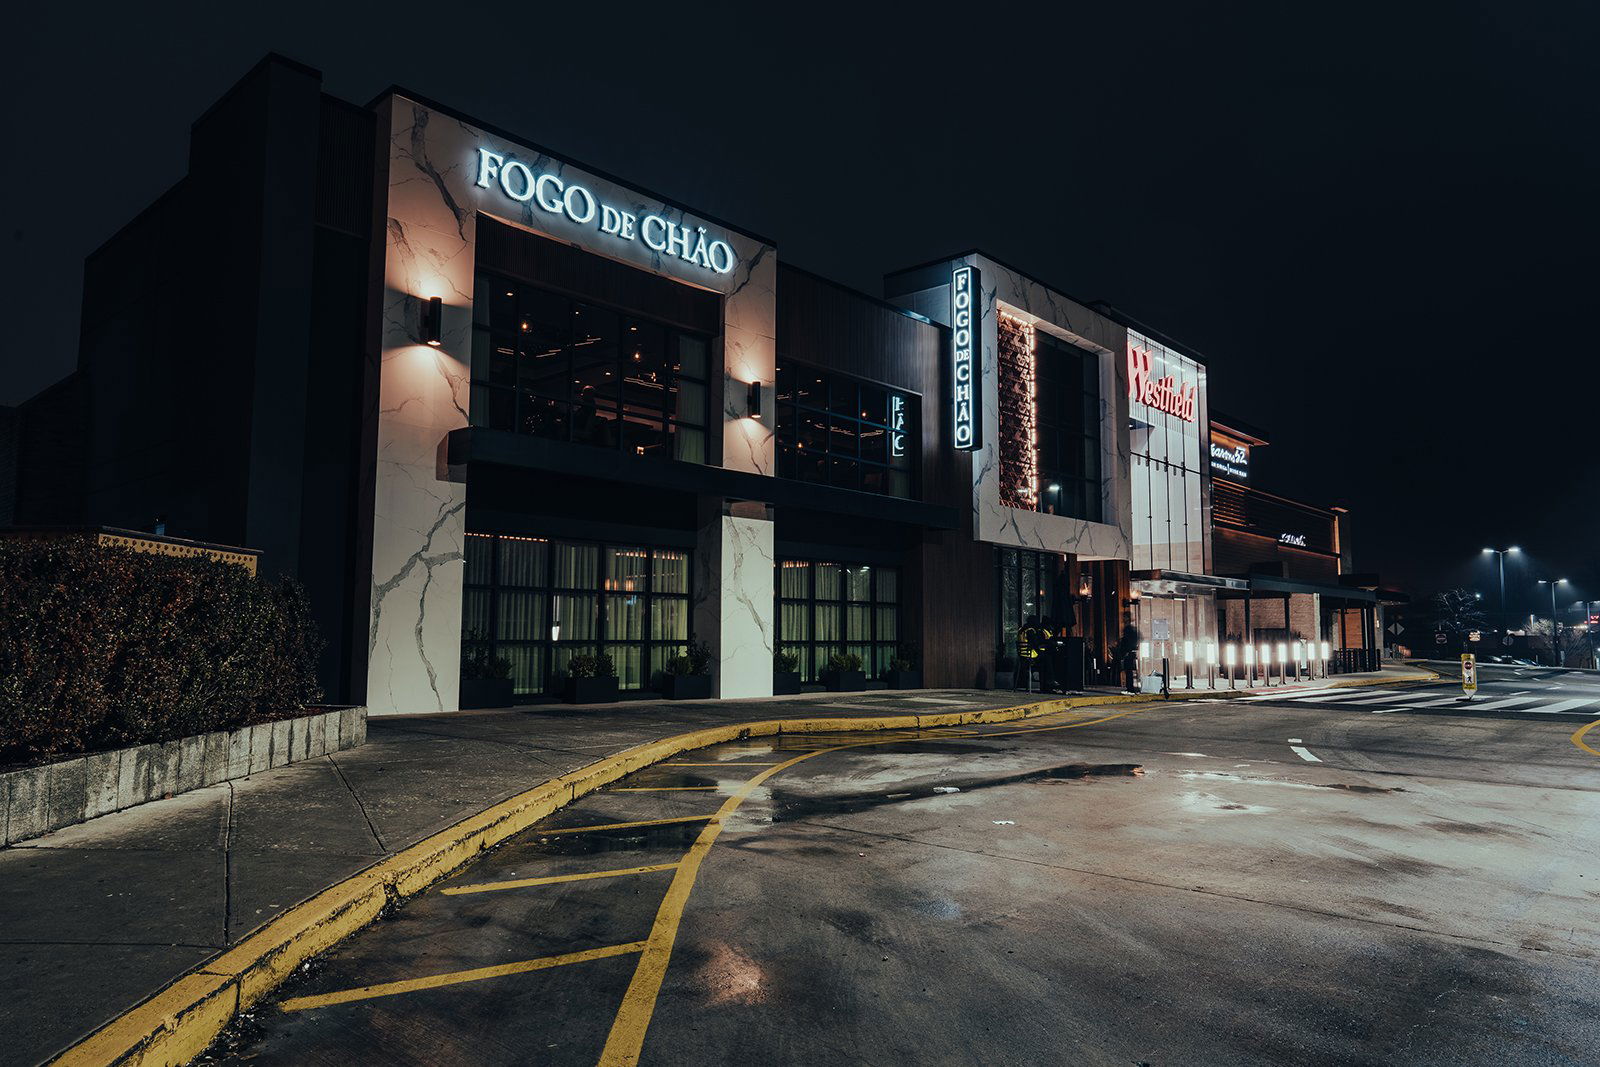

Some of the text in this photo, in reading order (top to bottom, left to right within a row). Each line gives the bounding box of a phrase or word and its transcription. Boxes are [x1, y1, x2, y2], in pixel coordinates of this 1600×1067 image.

[476, 148, 734, 274] FOGO DE CHÃO
[956, 274, 970, 442] FOGO DE CHÃO
[1127, 341, 1197, 423] Westfield
